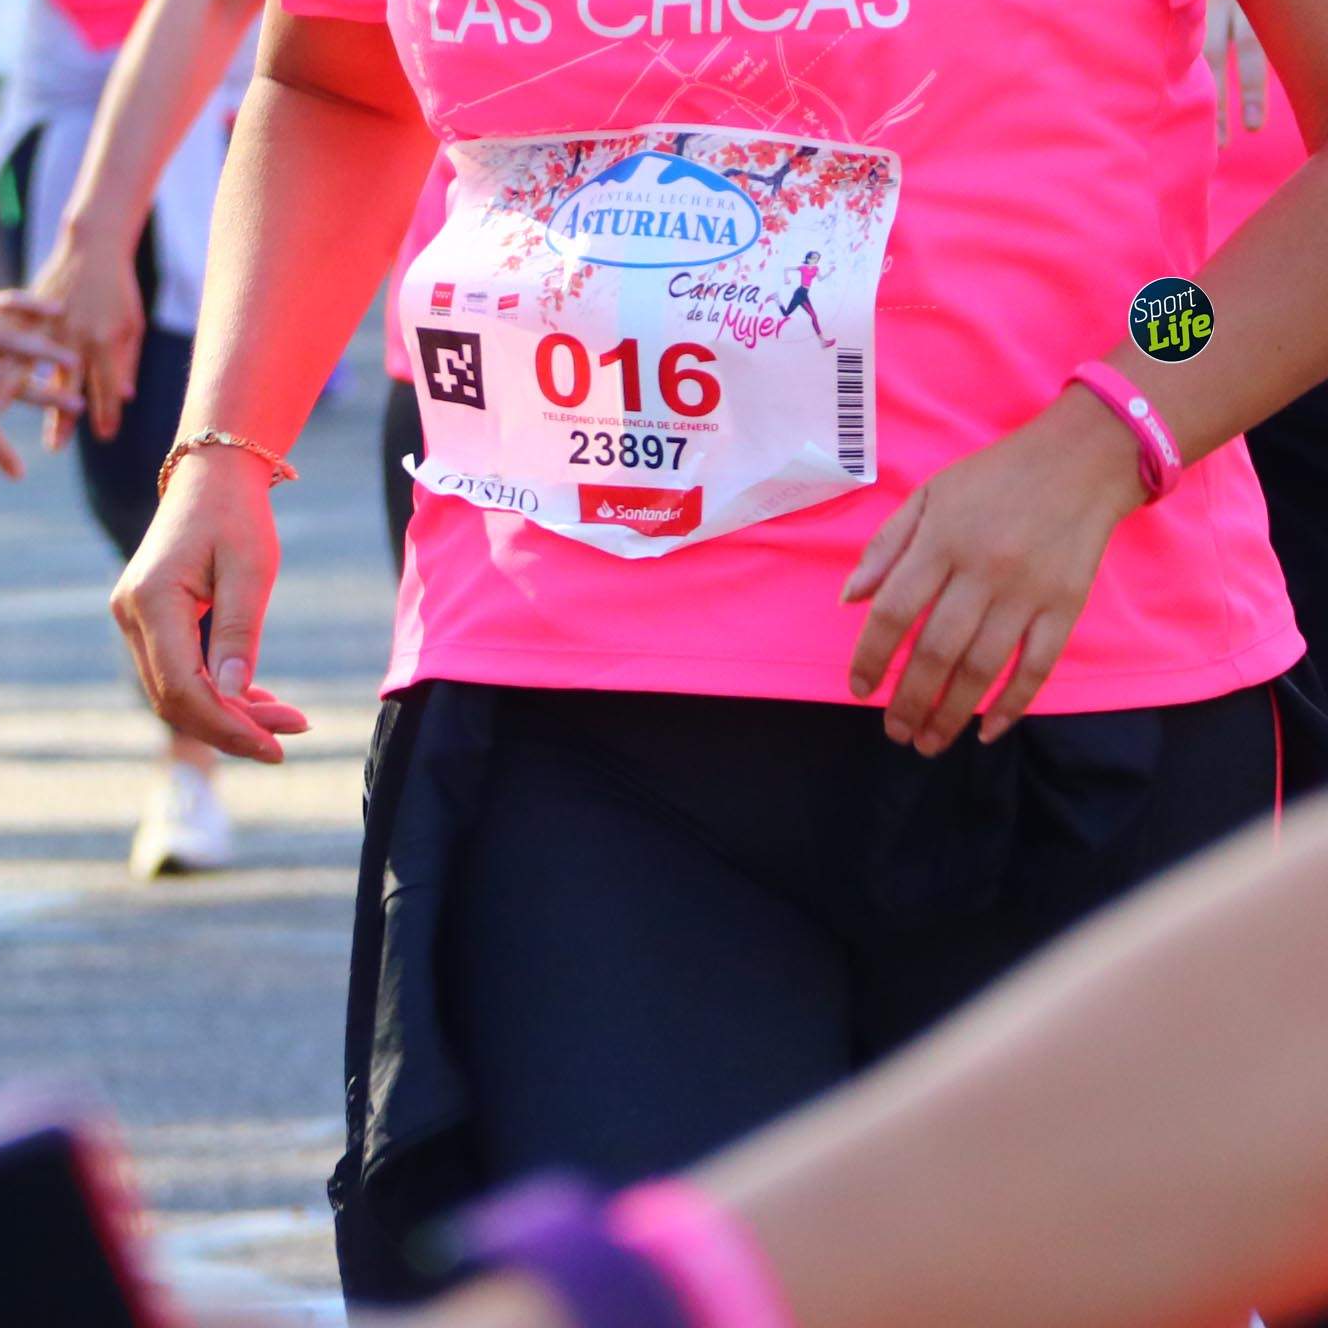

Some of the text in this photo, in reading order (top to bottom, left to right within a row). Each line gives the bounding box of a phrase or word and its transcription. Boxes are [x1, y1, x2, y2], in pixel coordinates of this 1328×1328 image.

[589, 191, 736, 211] CENTRAL LECHERA
[561, 201, 739, 246] ASTURIANA
[668, 271, 760, 304] Carrera
[686, 302, 791, 349] de la Mujer
[535, 332, 721, 418] 016
[542, 411, 595, 426] TELÉFONO
[598, 416, 655, 429] VIOLENCIA
[656, 421, 671, 430] DE
[569, 430, 688, 471] 23897
[438, 472, 539, 514] OYSHO
[615, 504, 684, 522] Santander
